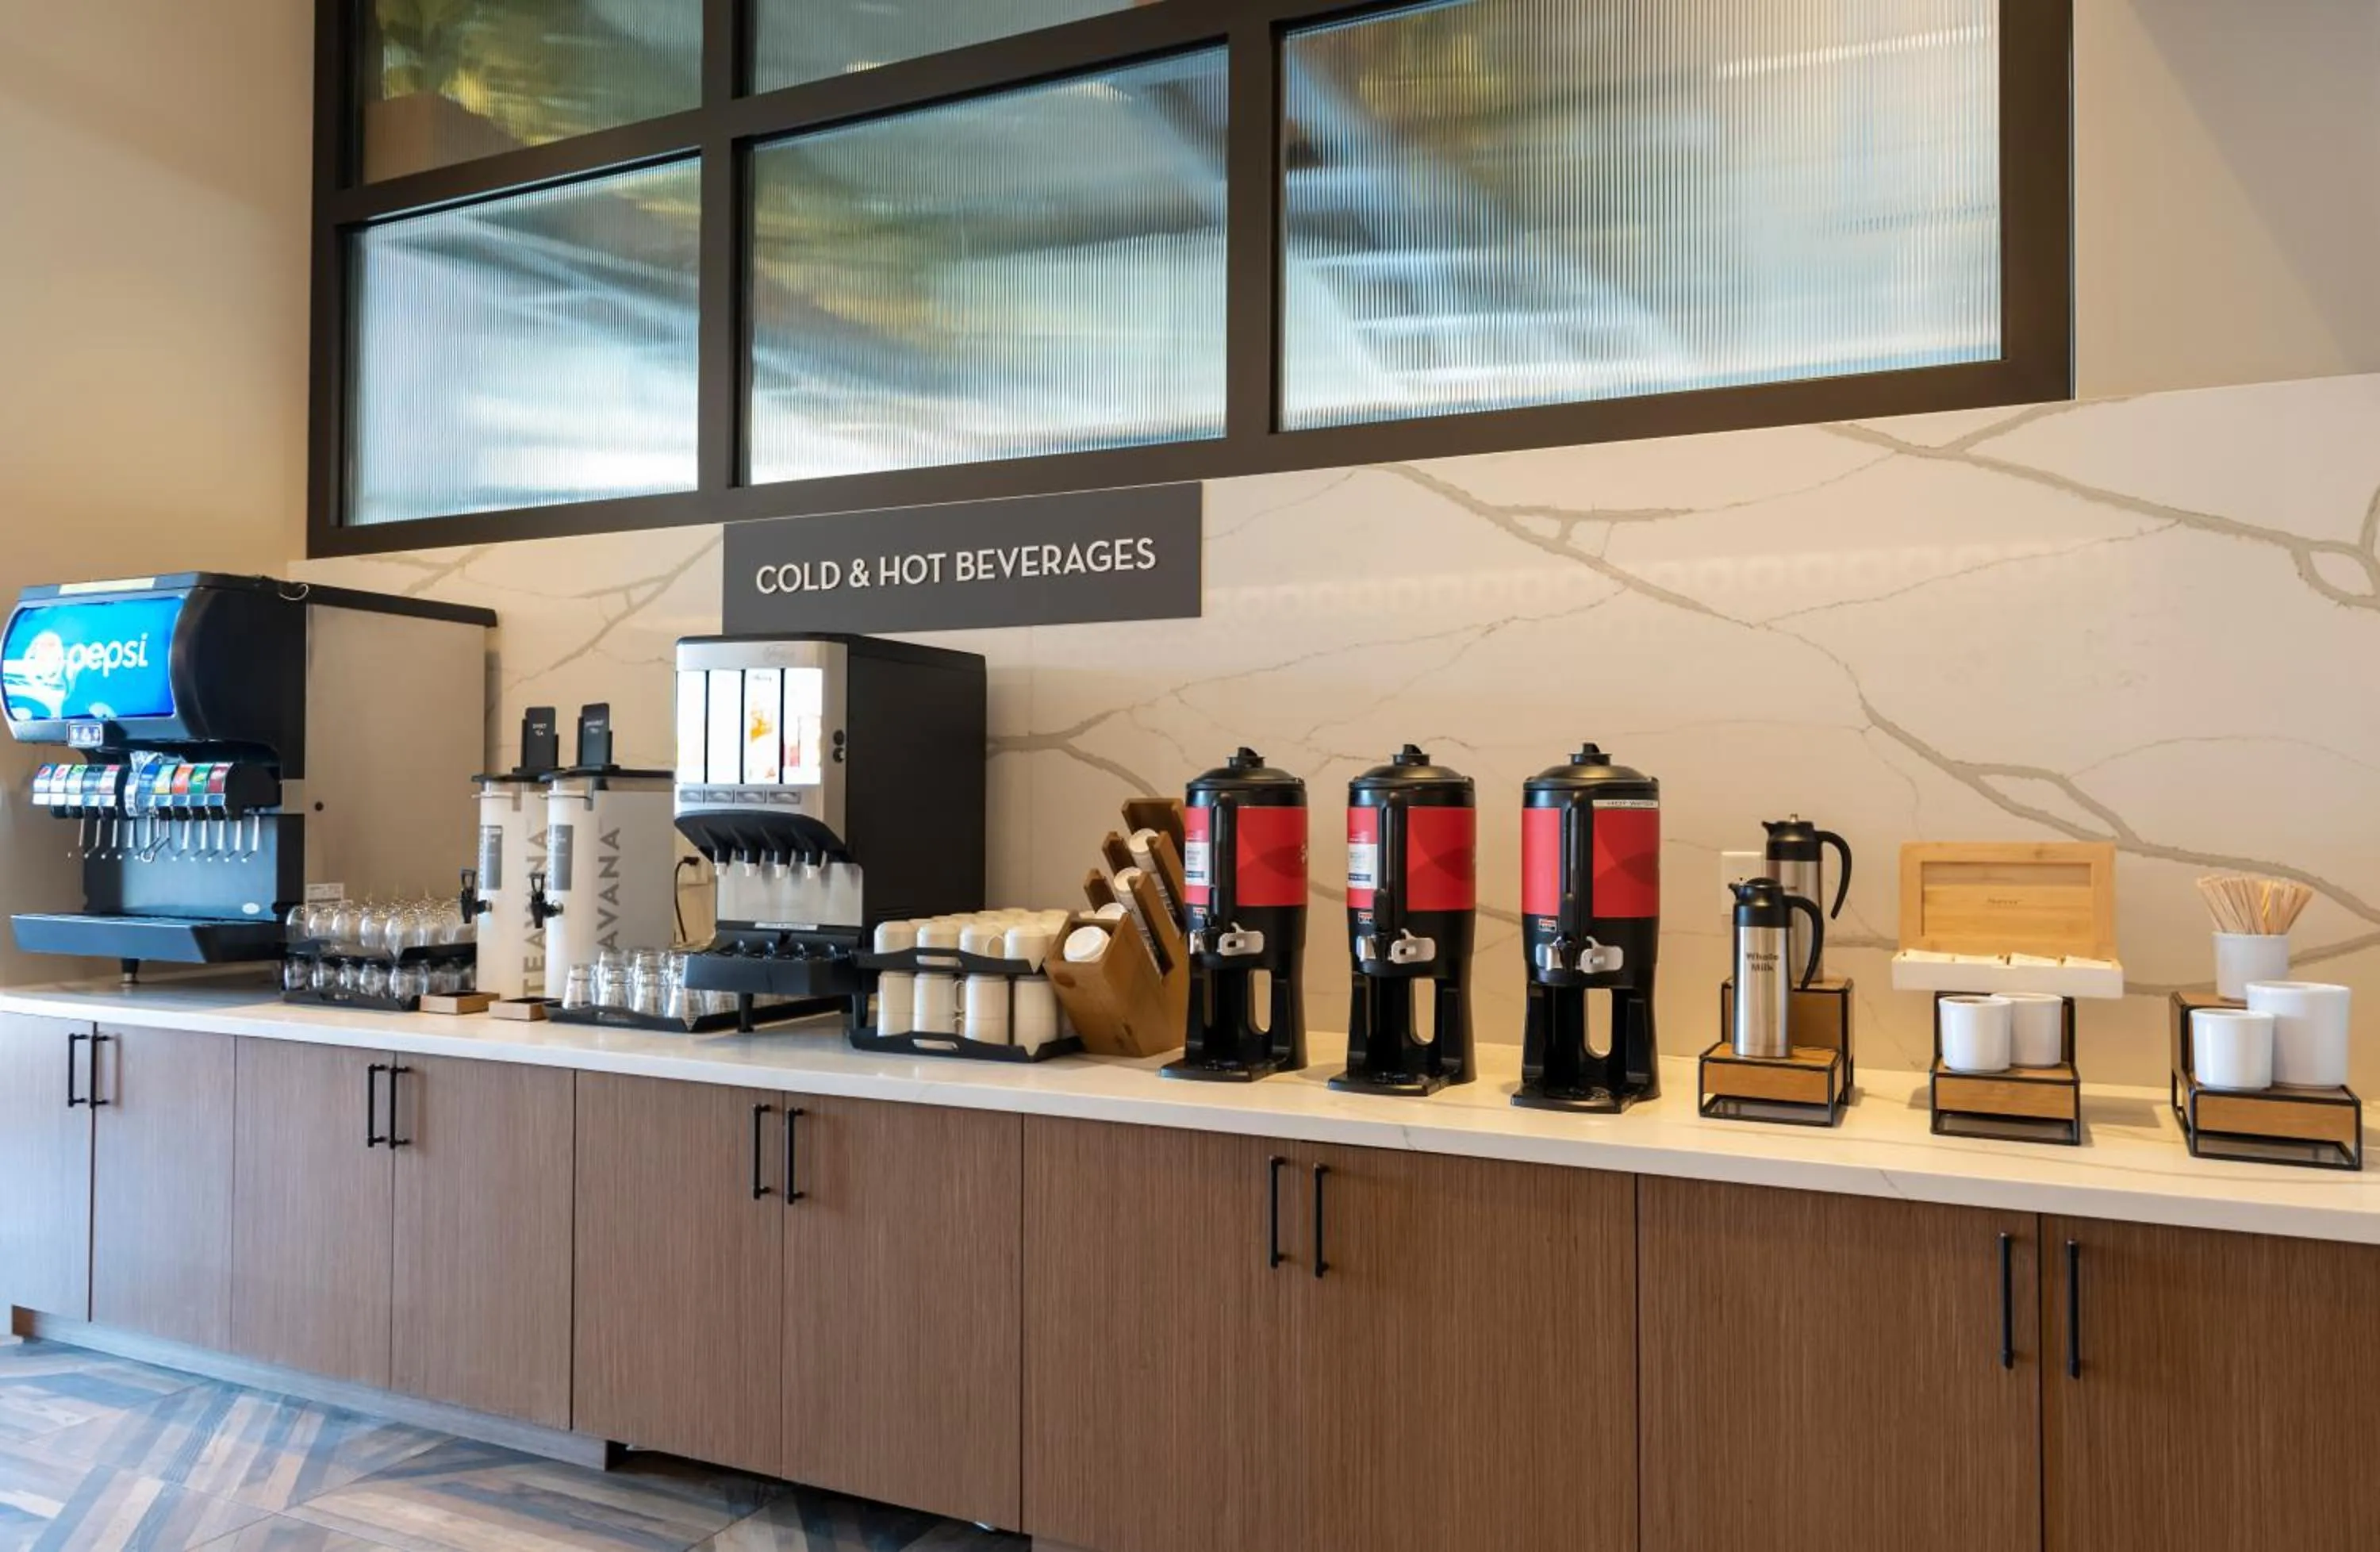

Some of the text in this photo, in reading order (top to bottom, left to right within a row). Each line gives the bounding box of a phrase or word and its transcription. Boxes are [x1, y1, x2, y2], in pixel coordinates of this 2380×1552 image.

[755, 536, 1157, 594] COLD & HOT BEVERAGES
[66, 632, 149, 678] pepsi
[1746, 952, 1779, 961] Whole
[1751, 962, 1775, 972] Milk
